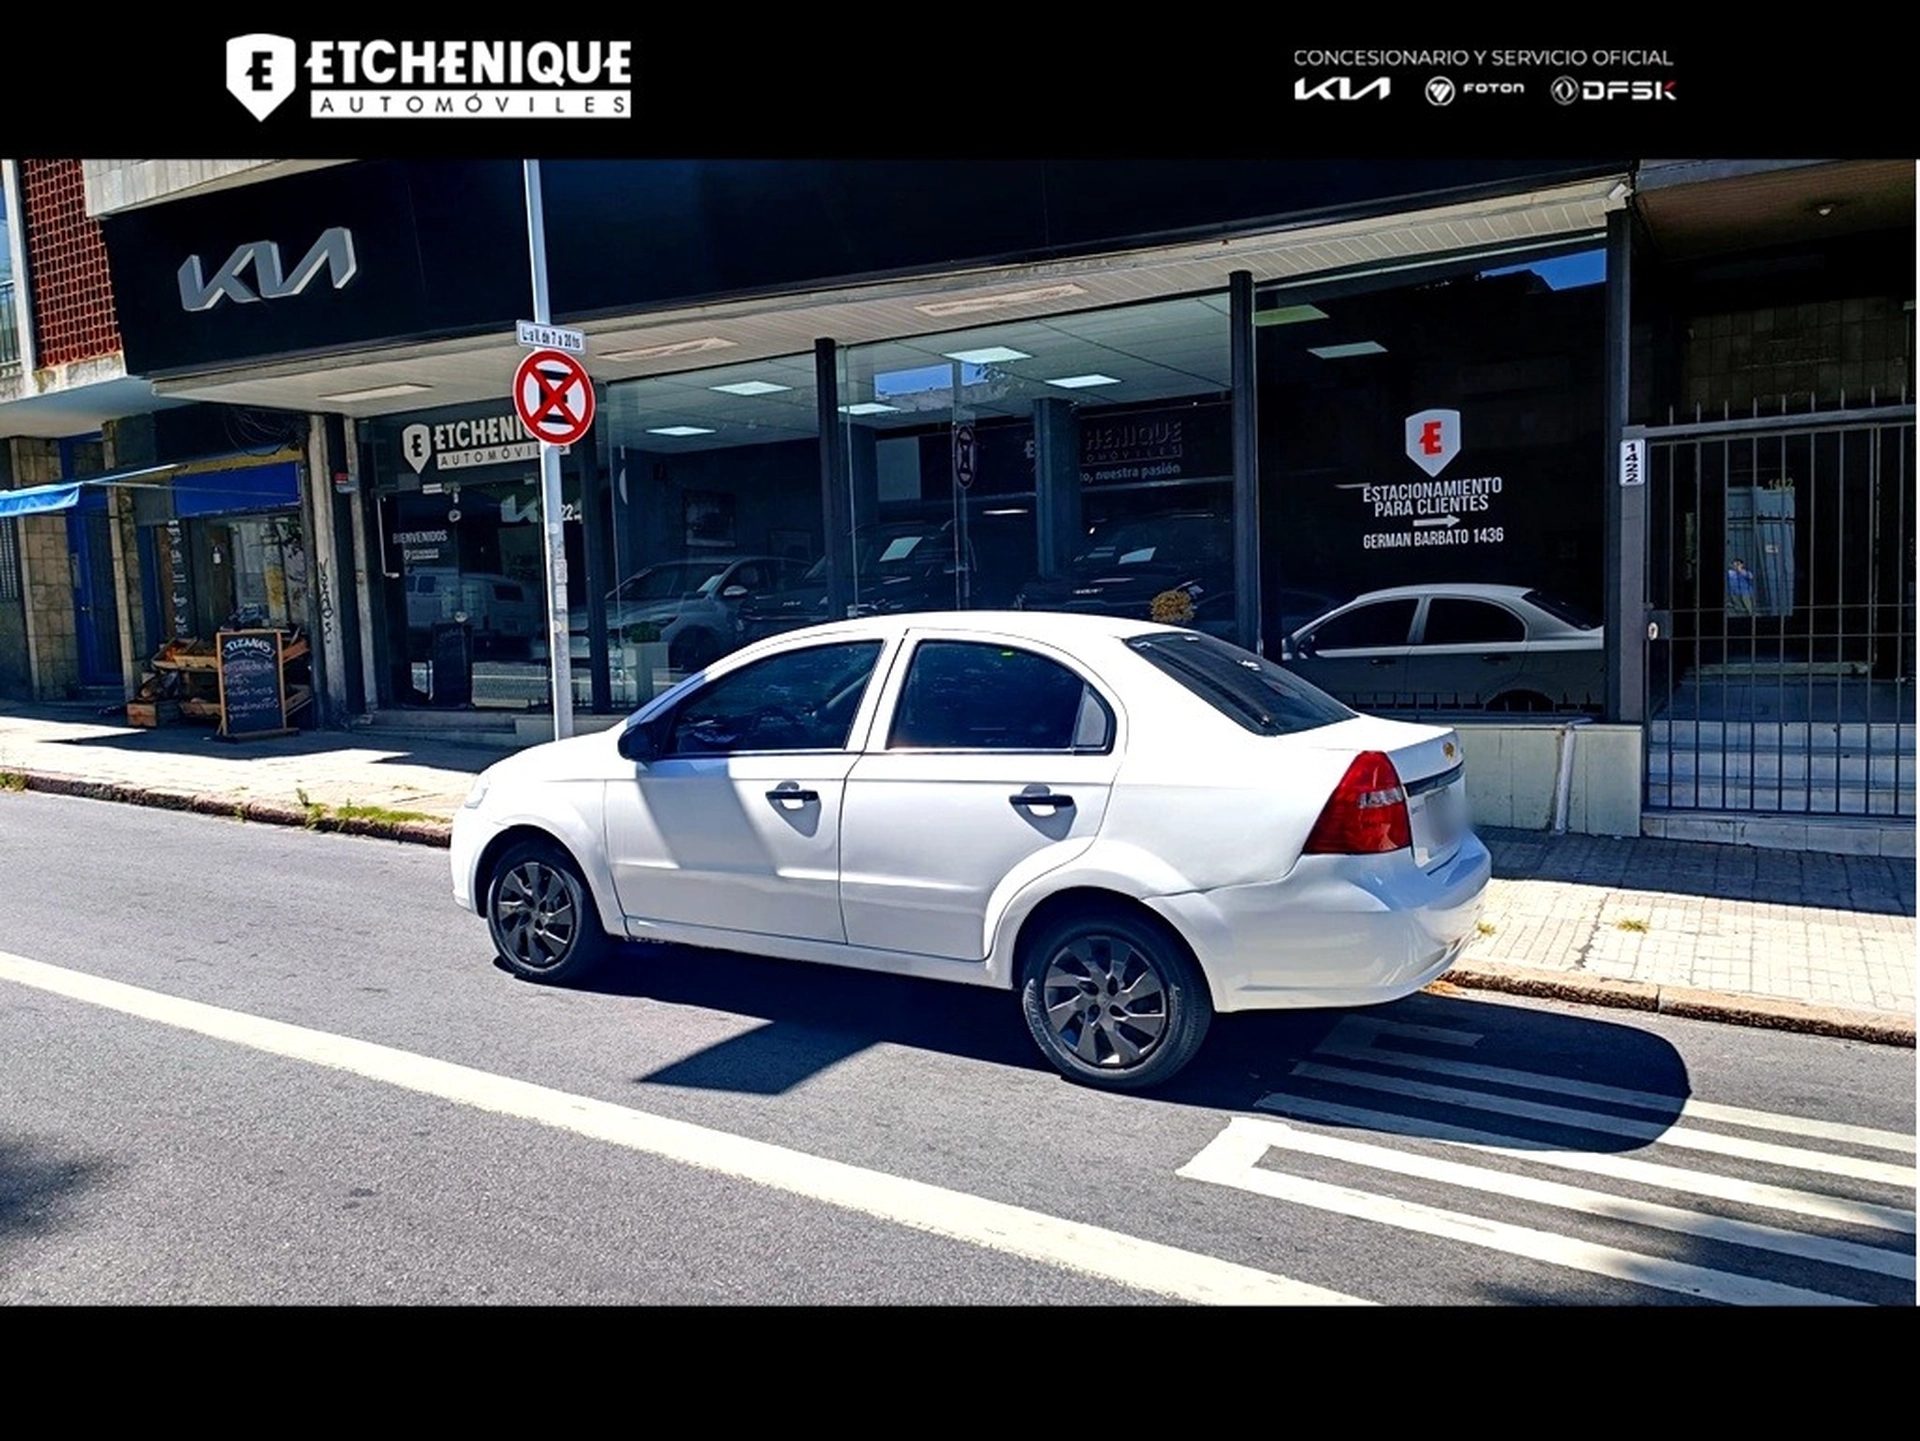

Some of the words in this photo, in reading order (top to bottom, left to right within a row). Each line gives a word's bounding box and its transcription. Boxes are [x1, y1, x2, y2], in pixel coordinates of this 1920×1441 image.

[177, 226, 357, 312] KIA
[434, 415, 534, 450] ETCHENI
[1095, 467, 1139, 480] nuestra
[1141, 462, 1181, 479] pasión
[1625, 443, 1638, 483] 1422
[1363, 477, 1503, 502] ESTACIONAMIENTO
[1374, 500, 1413, 517] PARA
[1417, 495, 1489, 515] CLIENTES
[393, 530, 449, 544] BIENVENIDOS
[1363, 533, 1411, 549] GERMAN
[1414, 530, 1469, 546] BARBATO
[1473, 528, 1504, 544] 1436
